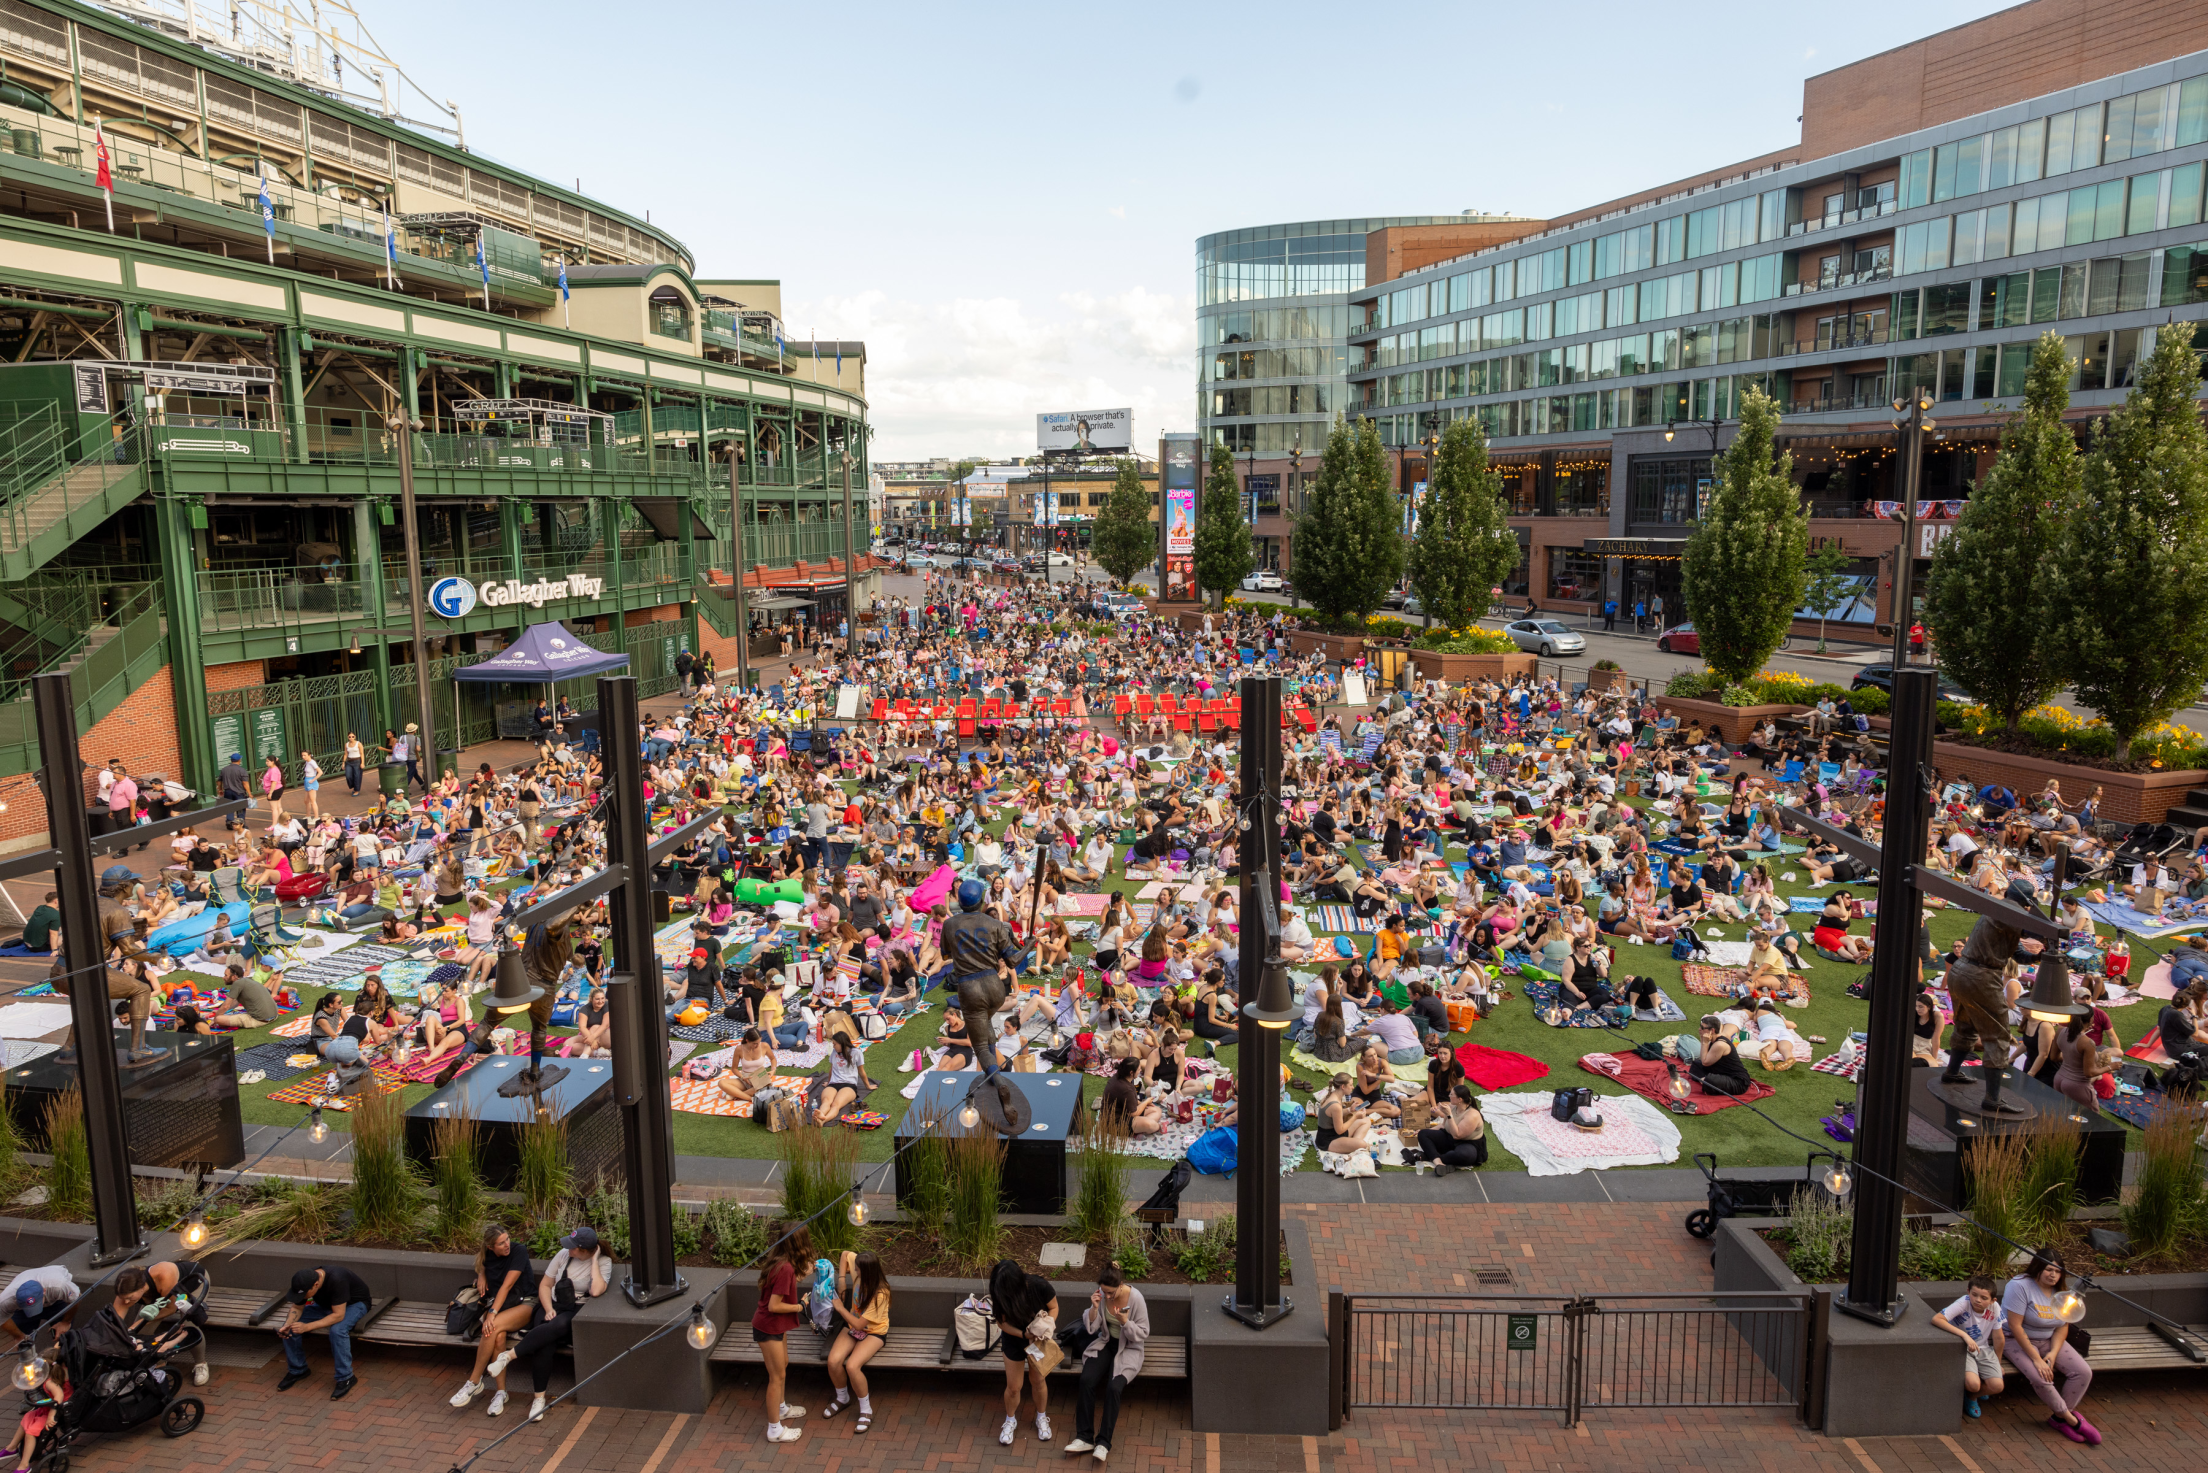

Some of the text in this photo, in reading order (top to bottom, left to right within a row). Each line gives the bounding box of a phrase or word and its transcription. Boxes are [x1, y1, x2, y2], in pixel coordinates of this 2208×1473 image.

[406, 212, 451, 223] GRILL
[469, 401, 513, 411] GRILL
[1077, 413, 1104, 421] browser
[1105, 411, 1124, 420] that's
[1052, 423, 1078, 432] actually
[1168, 489, 1192, 498] Barbie
[1597, 541, 1649, 552] ZACHARY
[479, 577, 568, 608] Gallagher
[566, 574, 602, 600] Way
[289, 642, 296, 651] 4
[544, 646, 592, 660] Gallagher Way
[955, 927, 989, 954] 26
